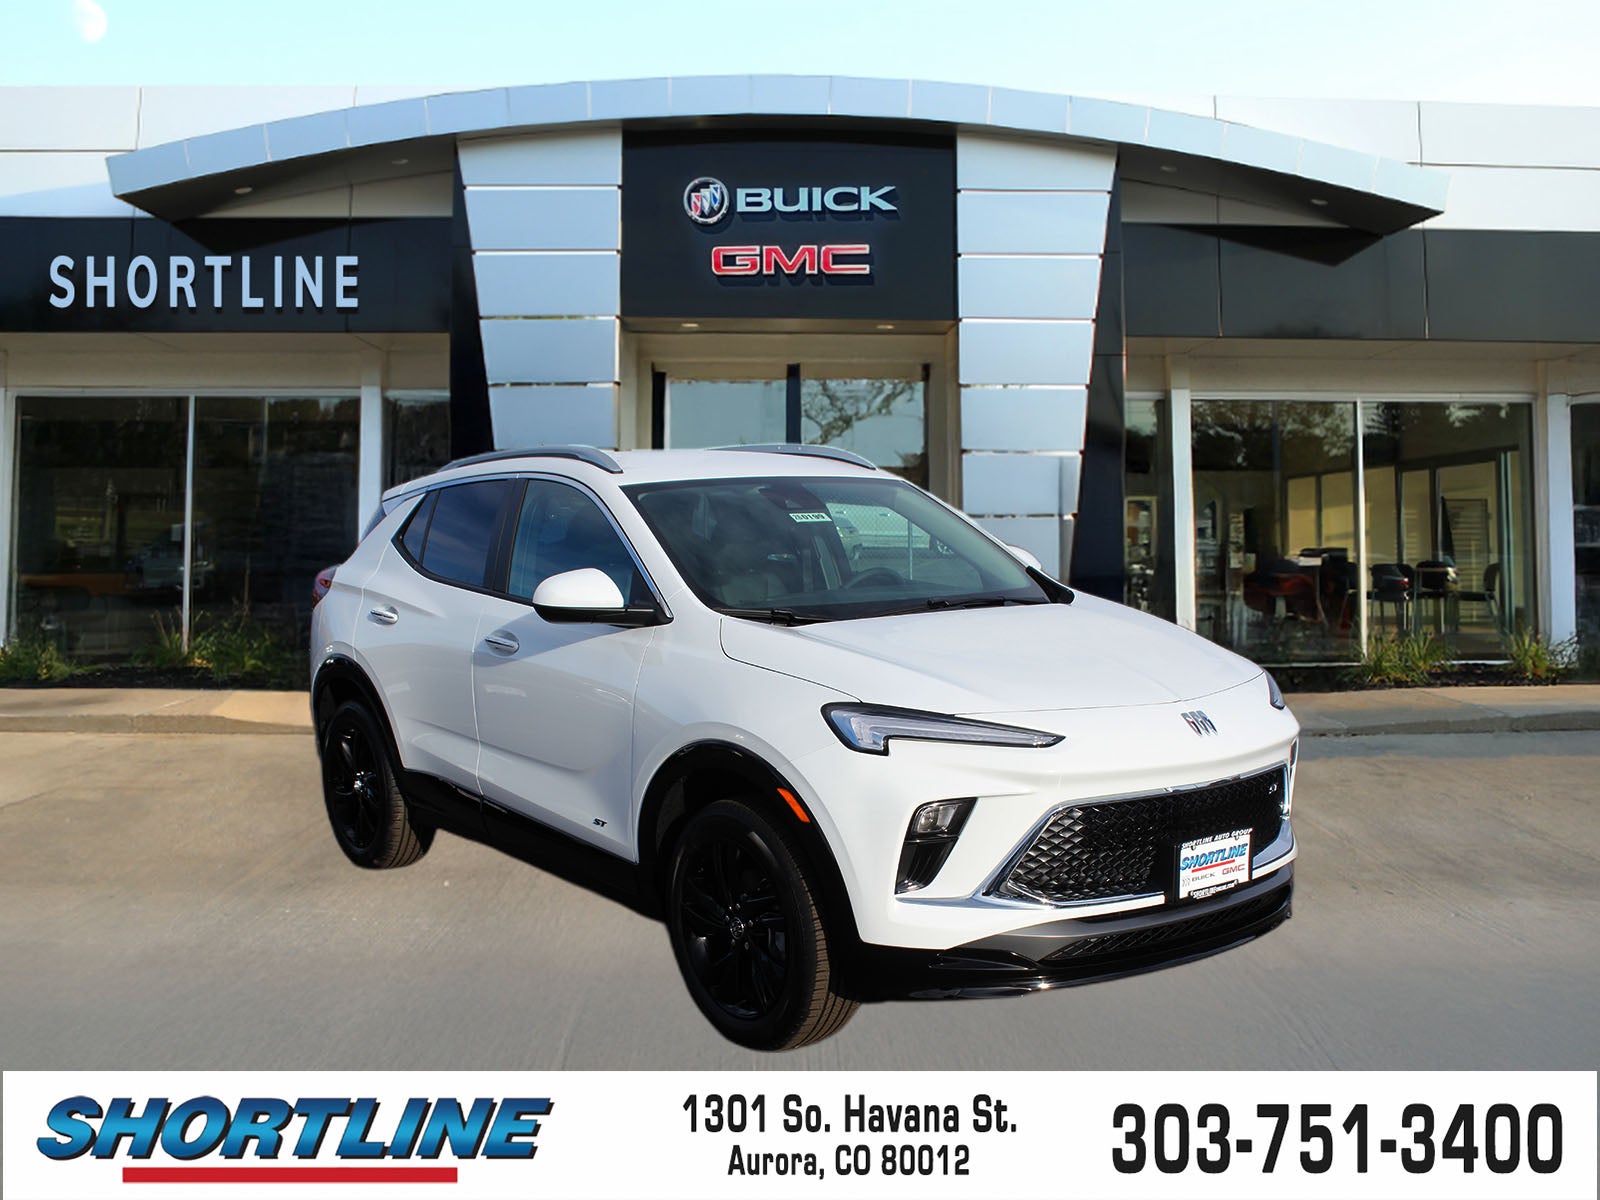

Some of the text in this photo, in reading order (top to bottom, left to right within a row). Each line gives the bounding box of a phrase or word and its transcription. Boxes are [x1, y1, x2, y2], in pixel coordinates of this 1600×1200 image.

[736, 185, 898, 213] BUICK
[711, 244, 870, 275] GMC
[49, 255, 359, 309] SHORTLINE
[592, 818, 608, 828] ST
[1214, 832, 1230, 841] AUTO
[1180, 843, 1248, 871] SHORTLINE
[1192, 864, 1246, 882] BUICK GMC
